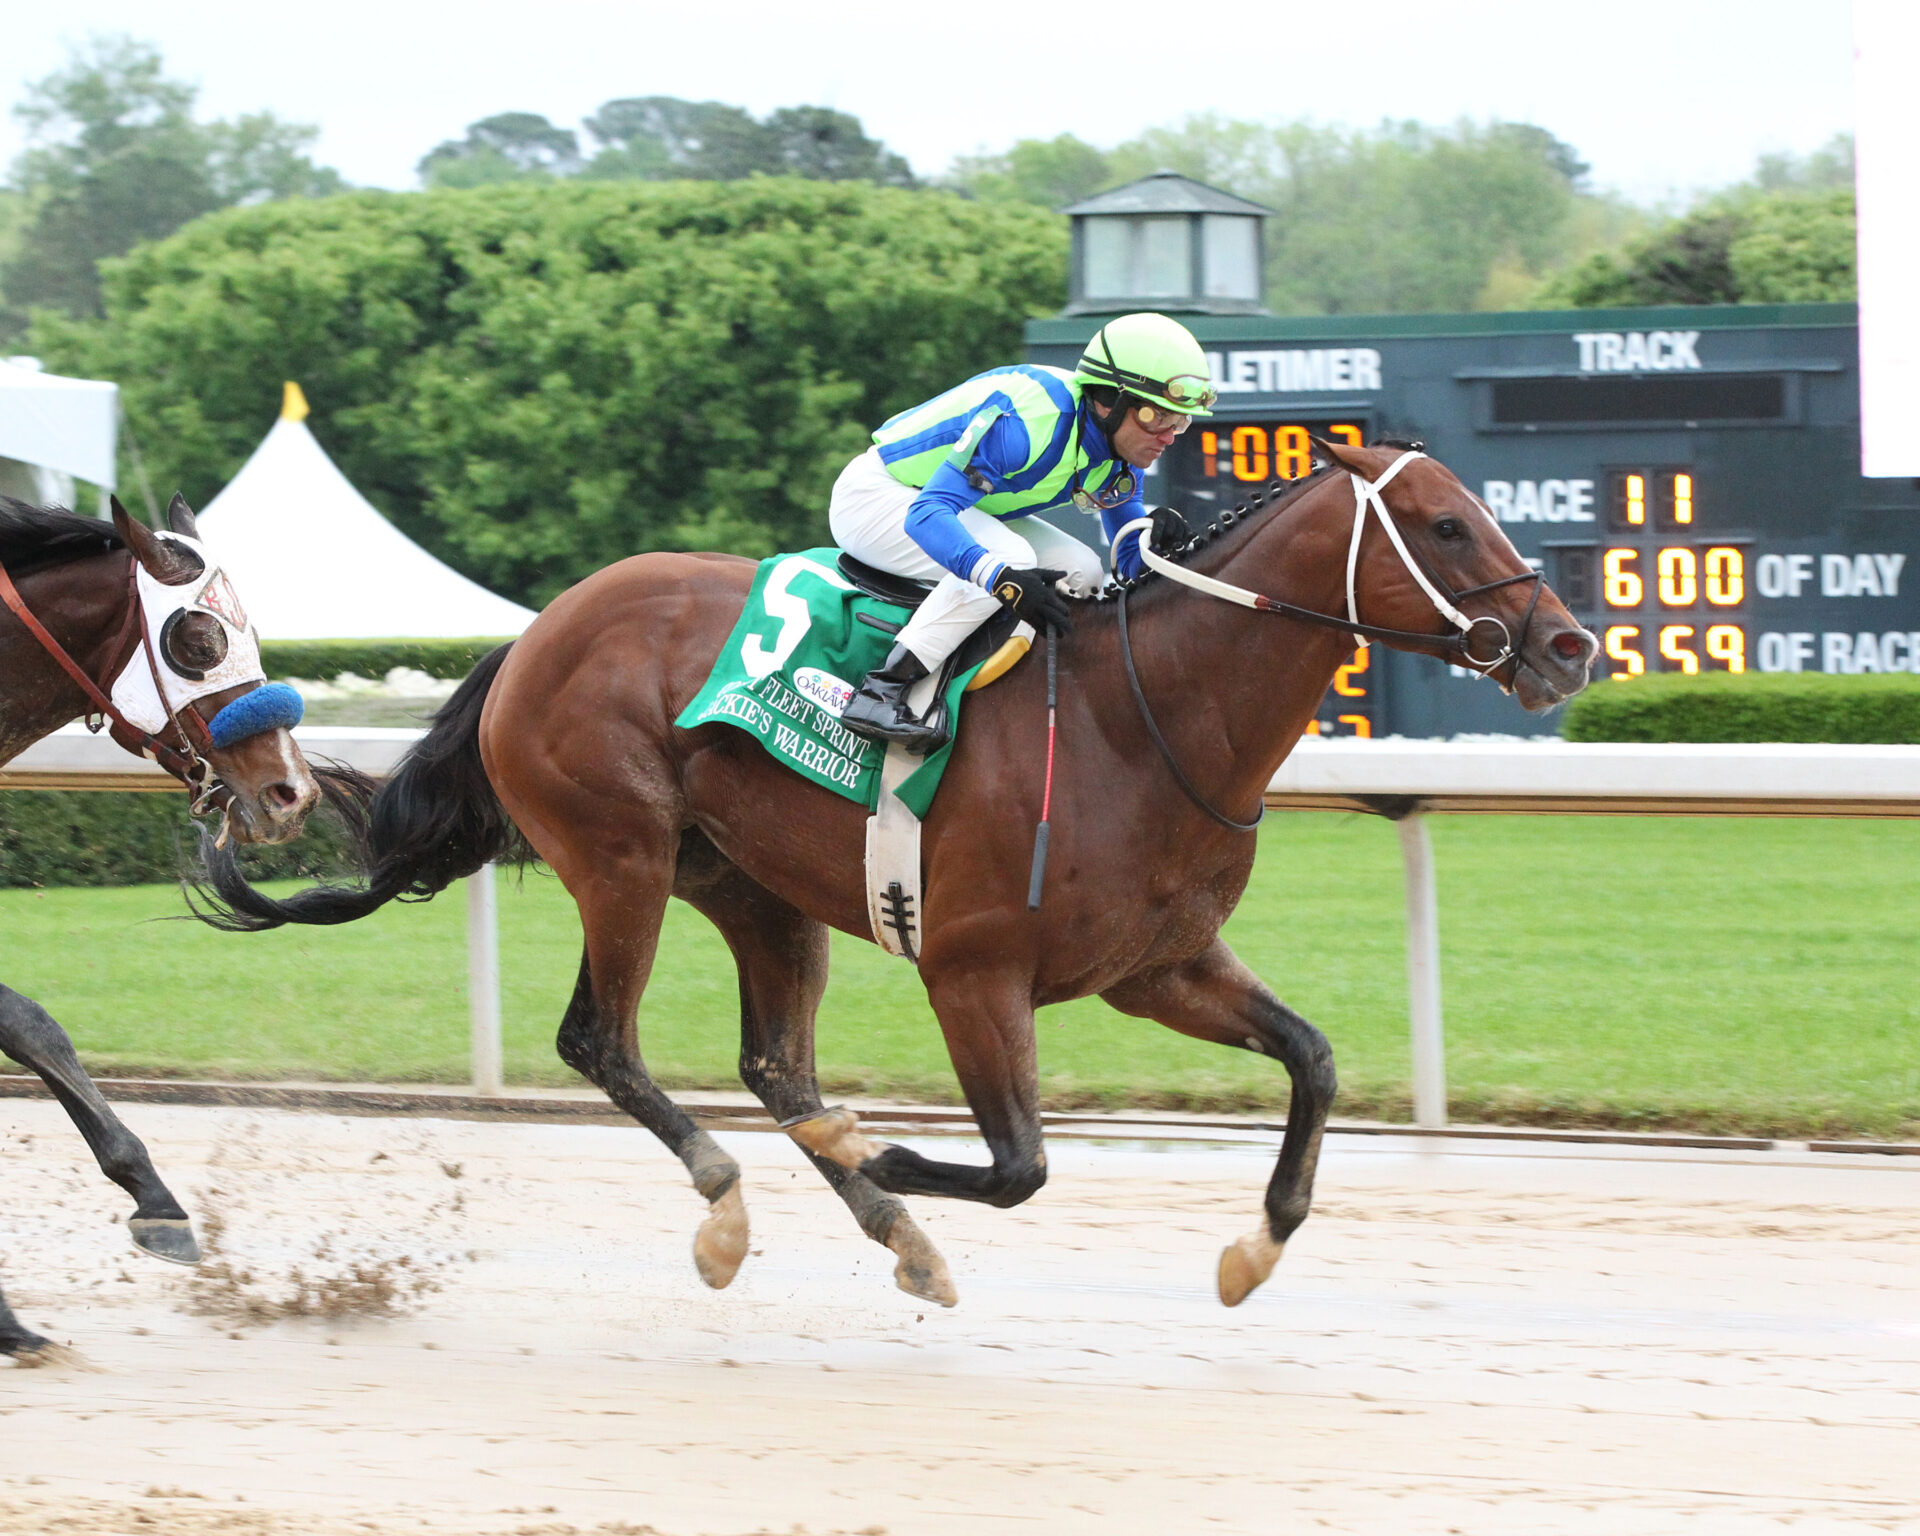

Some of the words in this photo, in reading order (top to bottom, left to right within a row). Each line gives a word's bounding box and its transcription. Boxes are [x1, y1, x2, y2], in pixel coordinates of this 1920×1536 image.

[1572, 331, 1702, 371] TRACK
[952, 416, 987, 453] 5
[1483, 479, 1596, 522] RACE
[1626, 474, 1692, 525] 11
[1756, 554, 1814, 598] OF
[1821, 553, 1906, 597] DAY
[740, 556, 863, 677] 5
[1757, 632, 1815, 672] OF
[758, 676, 814, 724] FLEET
[812, 710, 871, 763] SPRINT
[773, 723, 861, 789] WARRIOR
